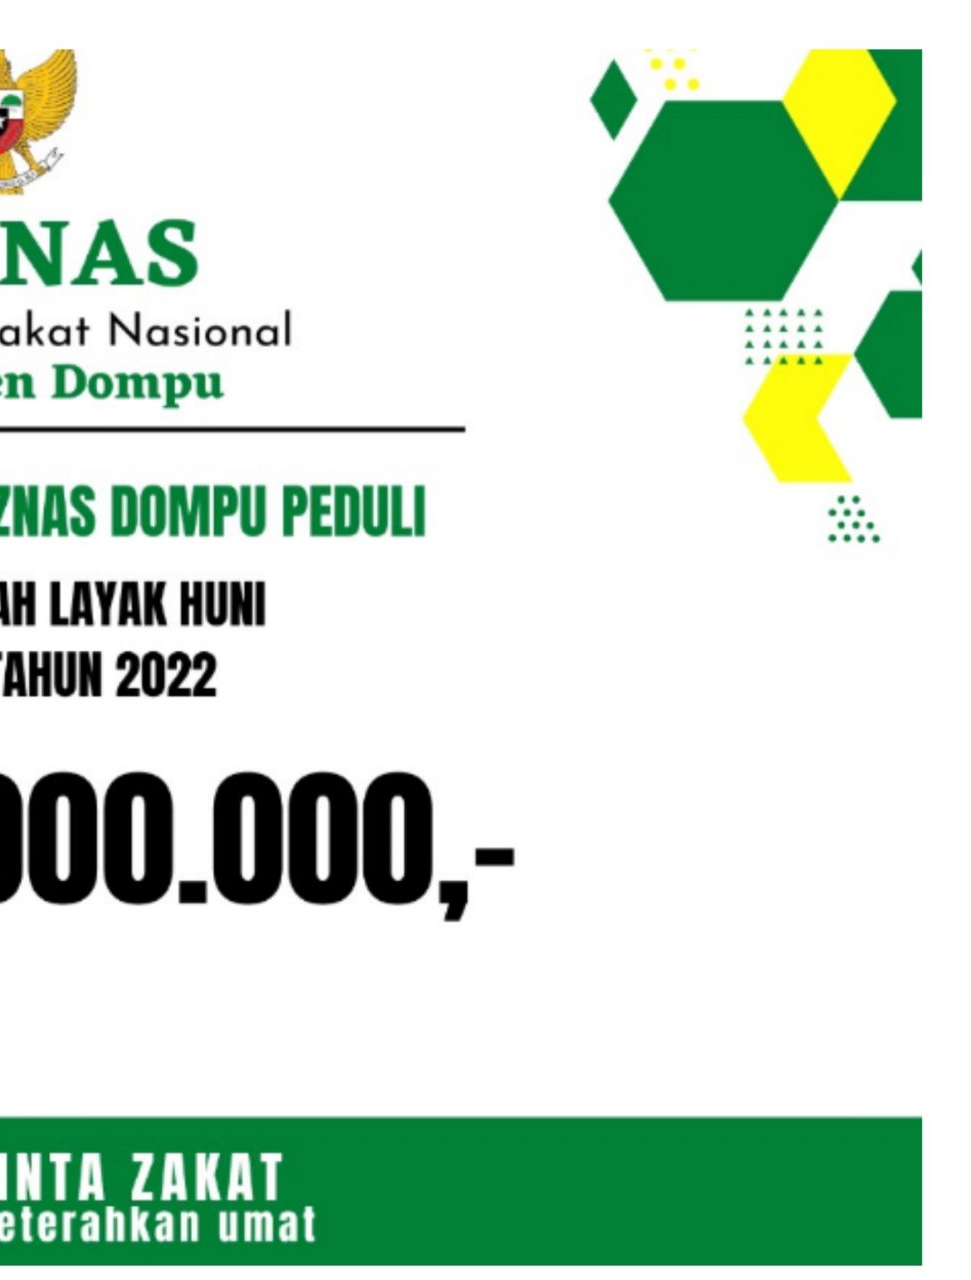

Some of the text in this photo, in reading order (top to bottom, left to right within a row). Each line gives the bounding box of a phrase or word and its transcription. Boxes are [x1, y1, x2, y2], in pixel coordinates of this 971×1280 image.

[110, 309, 291, 347] Nasional
[51, 362, 225, 409] Dompu
[111, 484, 267, 537] DOMPU
[282, 484, 426, 537] PEDULI
[50, 581, 167, 627] LAYAK
[180, 581, 265, 627] HUNI
[115, 651, 217, 697] 2022
[132, 1152, 283, 1201] ZAKAT
[219, 1205, 315, 1242] umat
